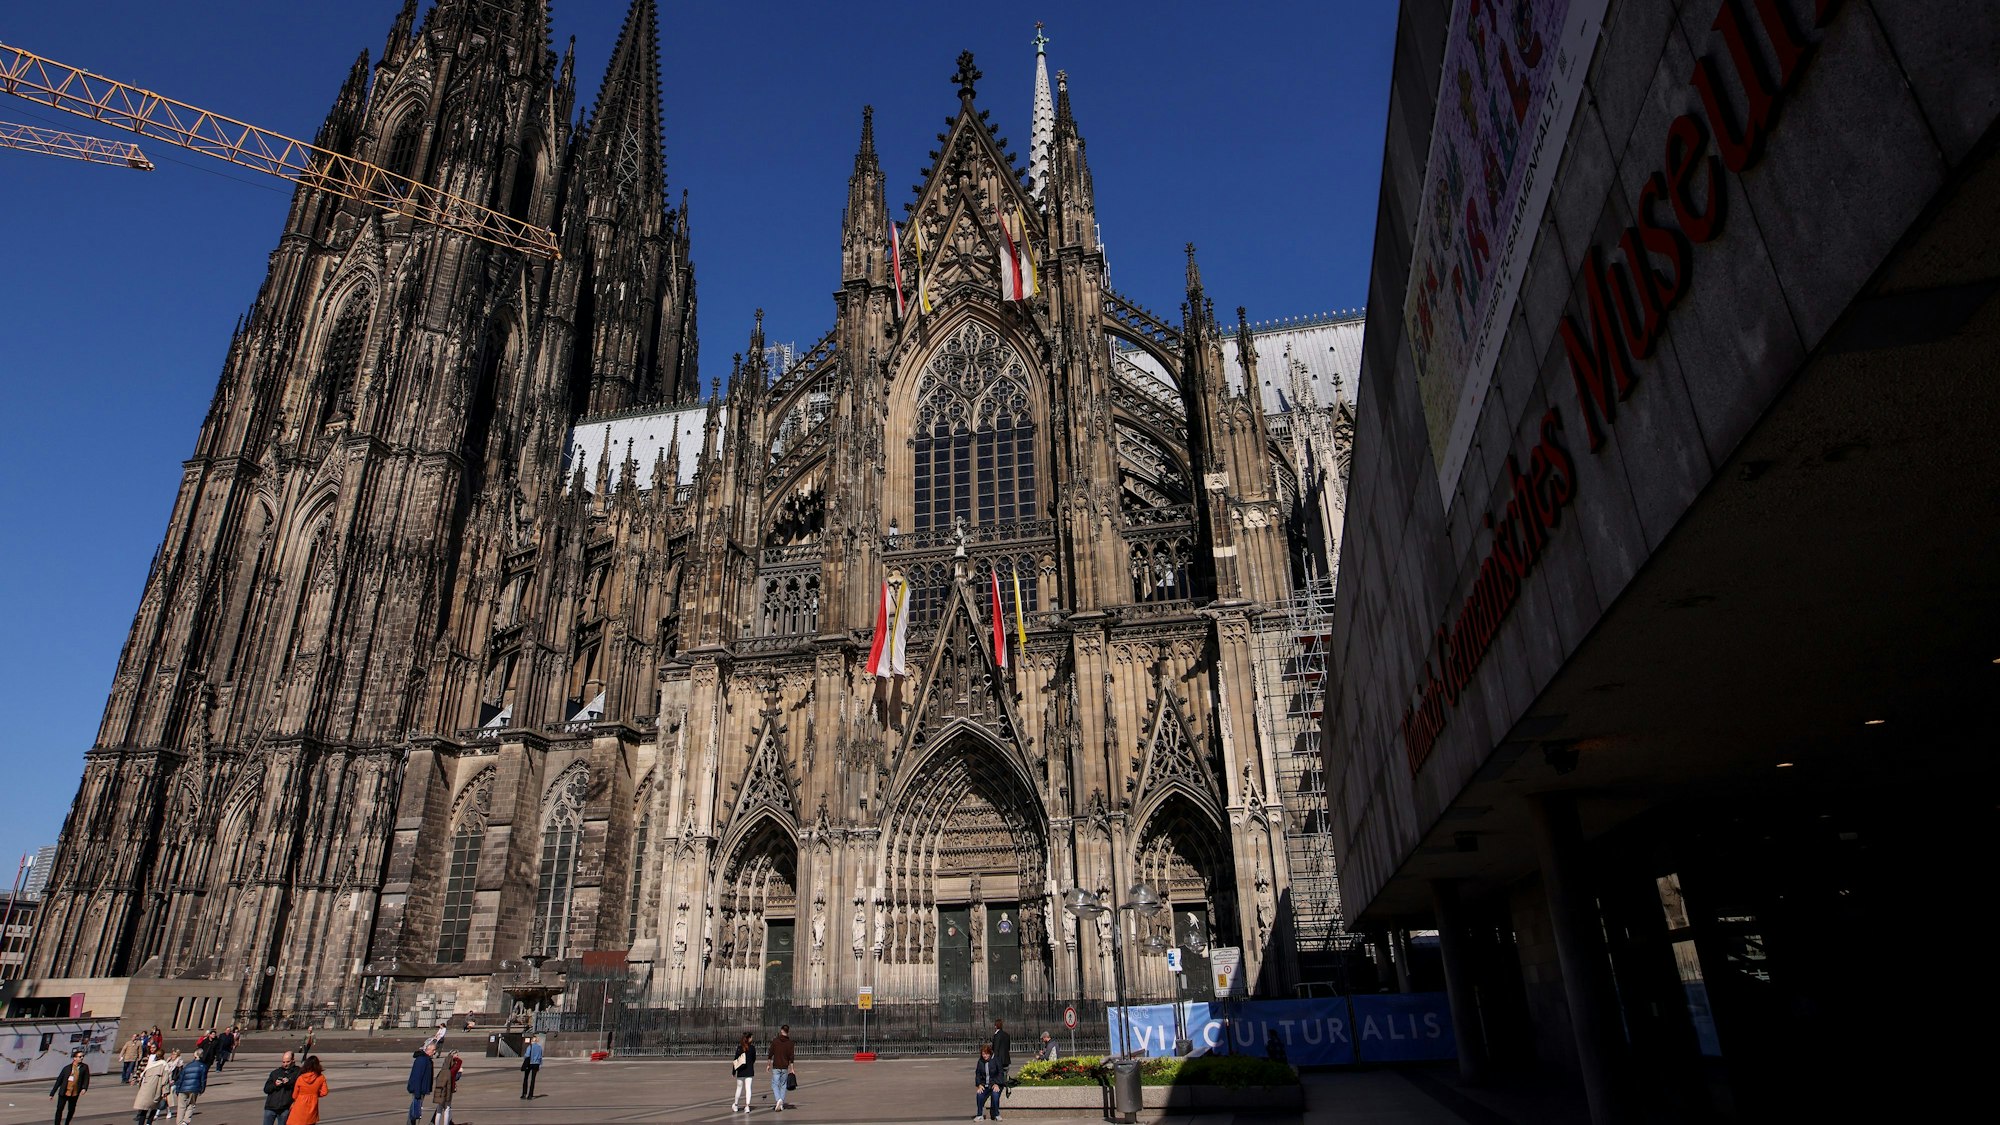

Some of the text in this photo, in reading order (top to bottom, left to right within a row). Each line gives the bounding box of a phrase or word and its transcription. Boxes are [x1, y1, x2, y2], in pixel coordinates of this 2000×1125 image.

[1483, 273, 1503, 340] ZEIGEN
[1500, 81, 1558, 278] ZUSAMMENHALT!
[1133, 1024, 1178, 1051] VI
